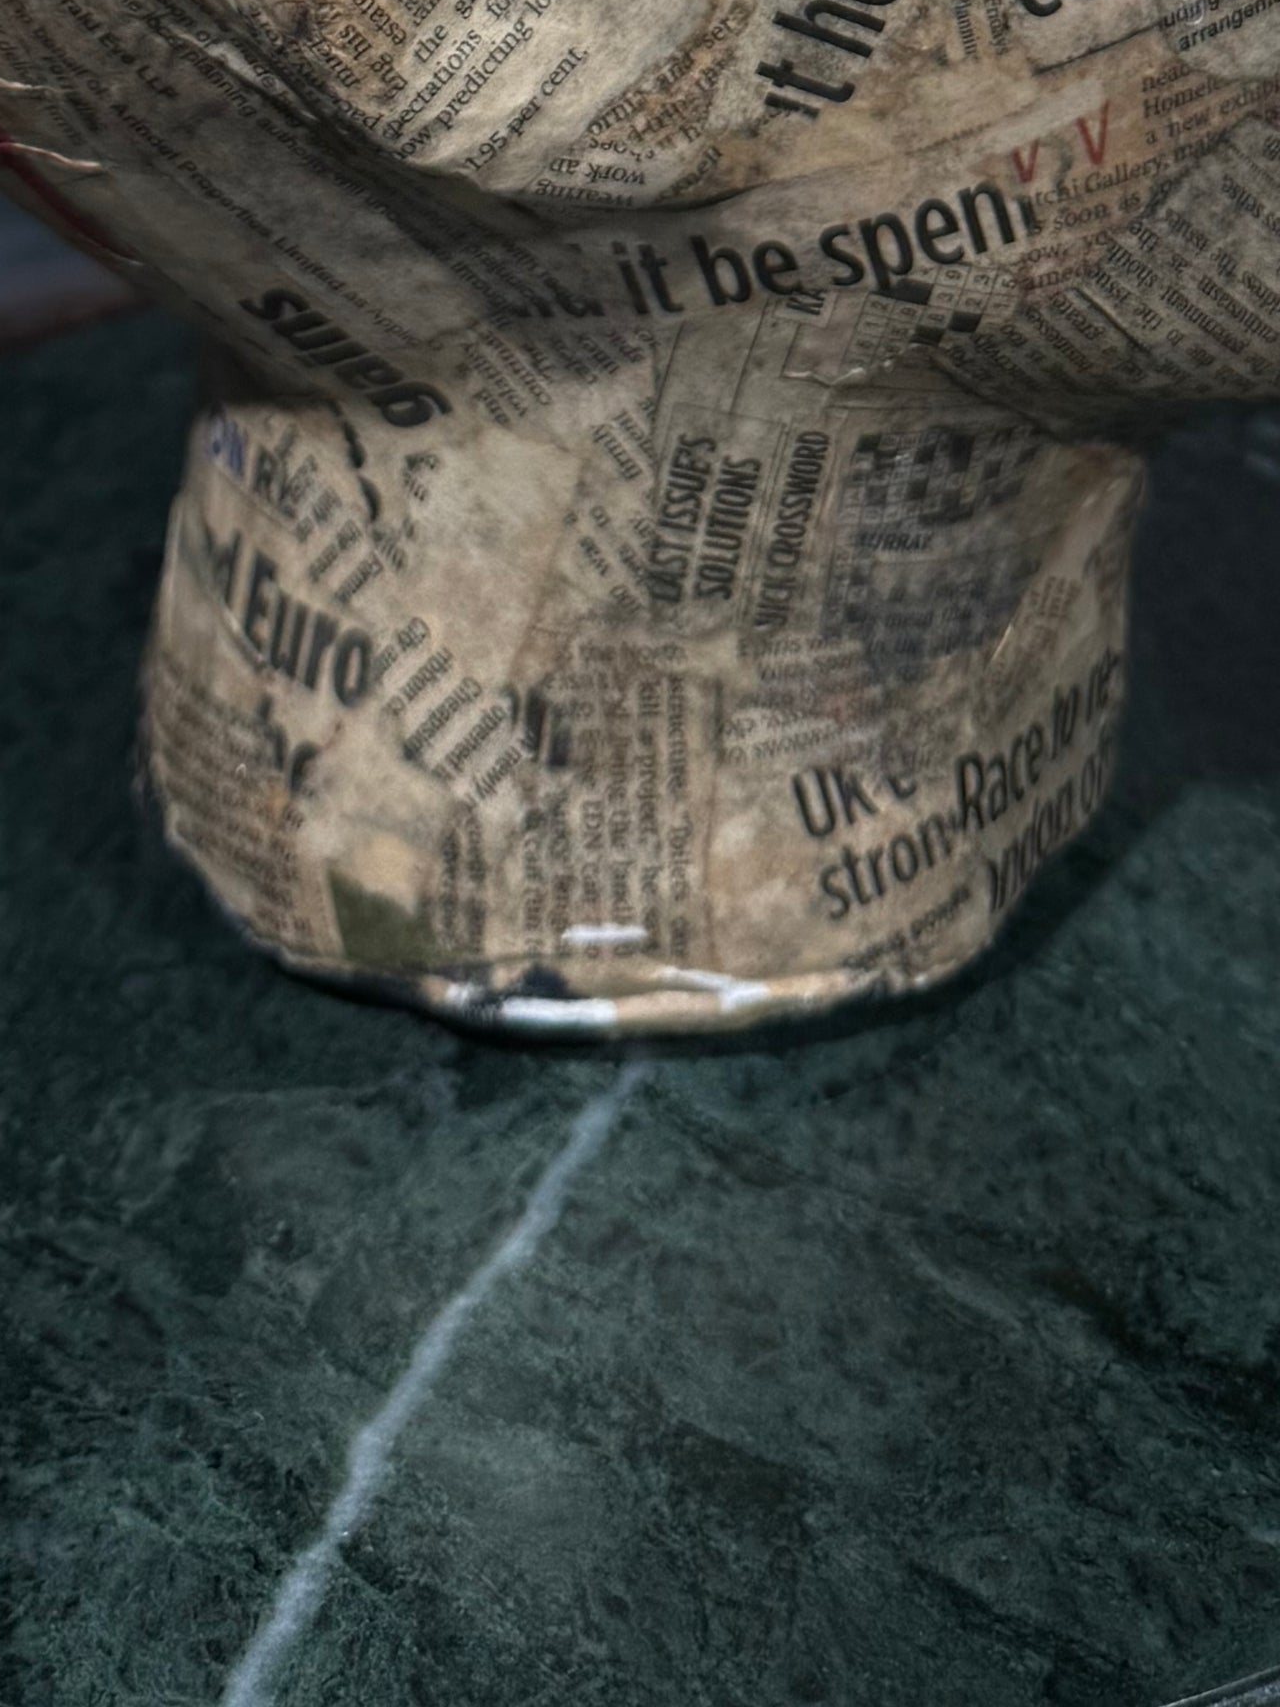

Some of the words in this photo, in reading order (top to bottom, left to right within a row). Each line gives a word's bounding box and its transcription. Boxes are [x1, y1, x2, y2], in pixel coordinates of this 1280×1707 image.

[99, 31, 140, 67] Eve
[137, 65, 178, 101] LLP
[182, 47, 266, 119] planning
[339, 24, 373, 60] his
[412, 23, 449, 64] the
[434, 16, 535, 131] predicting
[506, 96, 542, 137] per
[538, 44, 590, 98] cent.
[611, 241, 685, 317] it
[690, 234, 799, 307] be
[695, 457, 761, 599] SOLUTIONS
[767, 431, 828, 568] CROSSWORD
